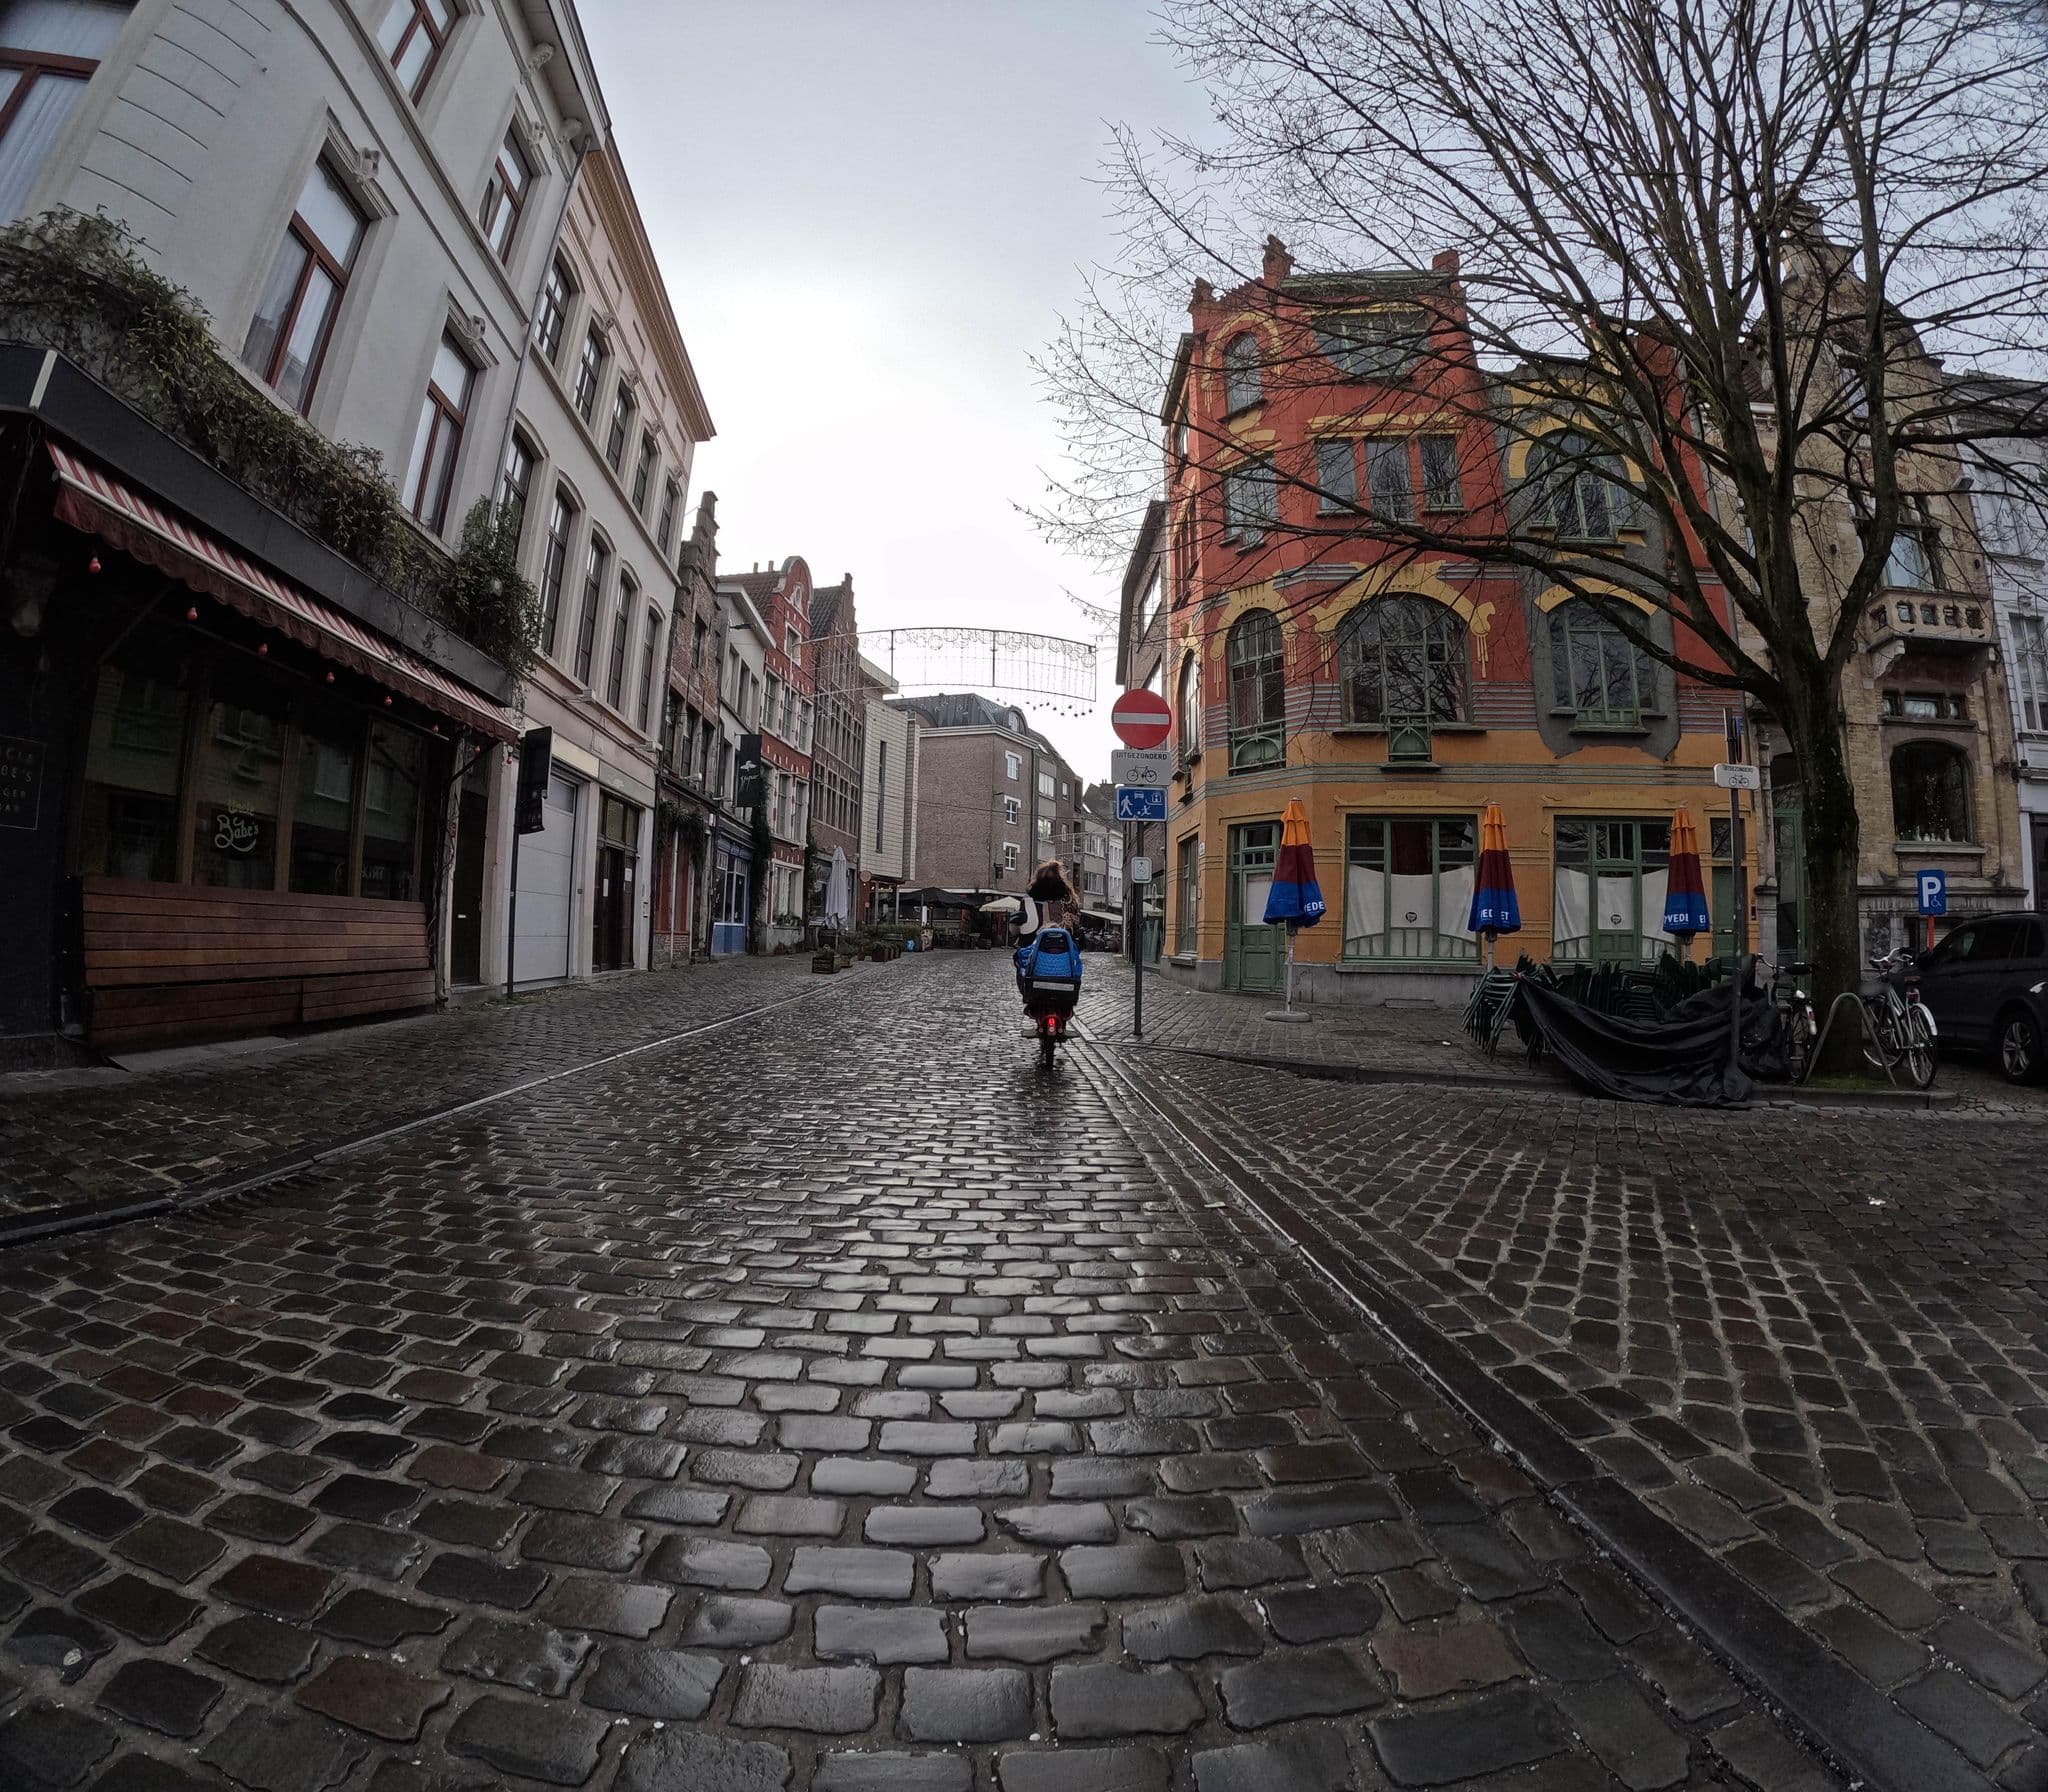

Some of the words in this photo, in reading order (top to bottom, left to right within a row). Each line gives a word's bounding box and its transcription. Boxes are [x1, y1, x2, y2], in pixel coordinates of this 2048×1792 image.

[0, 746, 33, 763] CLE
[1116, 751, 1167, 760] UITGEZONDERD
[1922, 876, 1941, 908] P
